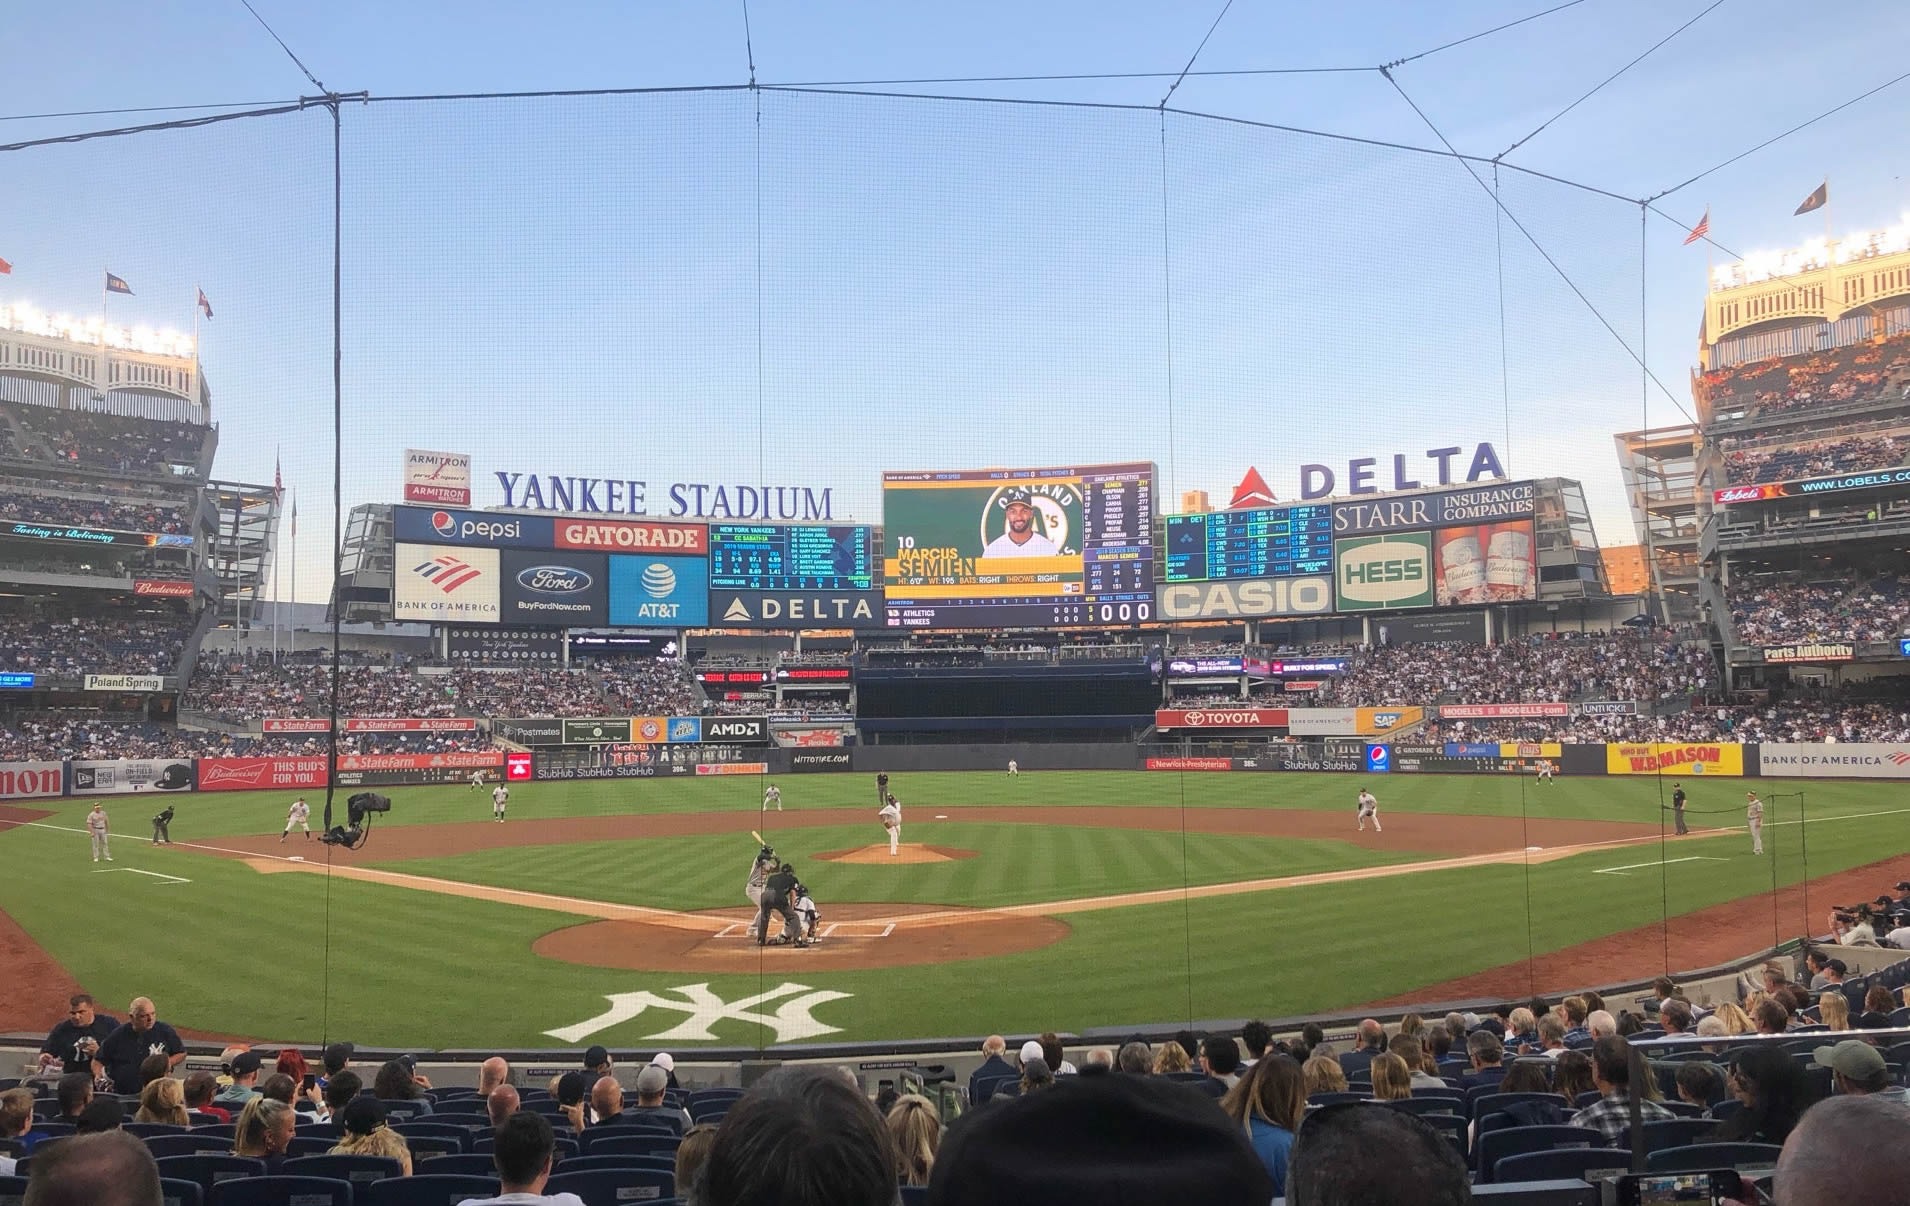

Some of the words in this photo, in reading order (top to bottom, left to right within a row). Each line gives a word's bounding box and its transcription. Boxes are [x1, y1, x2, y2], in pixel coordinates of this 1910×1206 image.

[410, 455, 467, 467] ARMITRON
[1300, 442, 1506, 500] DELTA
[413, 486, 464, 497] ARMITRON
[494, 471, 647, 515] YANKEE
[669, 483, 833, 521] STADIUM
[1444, 486, 1533, 508] INSURANCE
[1335, 500, 1431, 531] STARR
[1444, 500, 1533, 521] COMPANIES
[13, 525, 50, 538] Tasting
[66, 530, 114, 543] Believing
[461, 521, 520, 541] pepsi
[565, 525, 698, 548] GATORADE
[897, 537, 914, 548] 10
[898, 548, 958, 560] MARCUS
[898, 558, 976, 576] SEMIEN
[1346, 559, 1423, 584] HESS
[532, 569, 577, 590] Ford
[136, 583, 193, 594] Budweiser
[1163, 579, 1330, 618] CASIO
[397, 602, 428, 610] BANK
[447, 603, 496, 612] AMERICA
[518, 601, 591, 612] BuyFordNow.com
[639, 604, 680, 618] AT&T
[762, 599, 872, 619] DELTA
[1101, 604, 1112, 621] 0
[1119, 604, 1130, 620] 0
[1138, 603, 1149, 620] 0
[1764, 648, 1795, 658] Parts
[1797, 644, 1853, 657] Authority
[90, 676, 124, 688] Poland
[126, 676, 158, 690] Spring
[1444, 706, 1483, 716] MODELL'S
[1500, 706, 1564, 714] MODELLS.com
[1206, 713, 1260, 724] TOYOTA
[1374, 716, 1396, 726] SAP
[518, 728, 560, 736] Postmates
[710, 724, 748, 736] AMD
[794, 754, 849, 764] NITTOTIRE.COM
[1660, 747, 1720, 768] MASON
[1763, 756, 1798, 764] BANK
[1821, 757, 1882, 766] AMERICA
[273, 762, 295, 772] THIS
[298, 762, 326, 771] BUD'S
[1284, 760, 1320, 770] StubHub
[1323, 760, 1357, 770] StubHub
[209, 768, 260, 779] Budweiser
[538, 768, 574, 778] StubHub
[577, 768, 614, 777] StubHub
[617, 766, 654, 776] StubHub
[273, 774, 292, 783] FOR
[294, 774, 316, 782] YOU.
